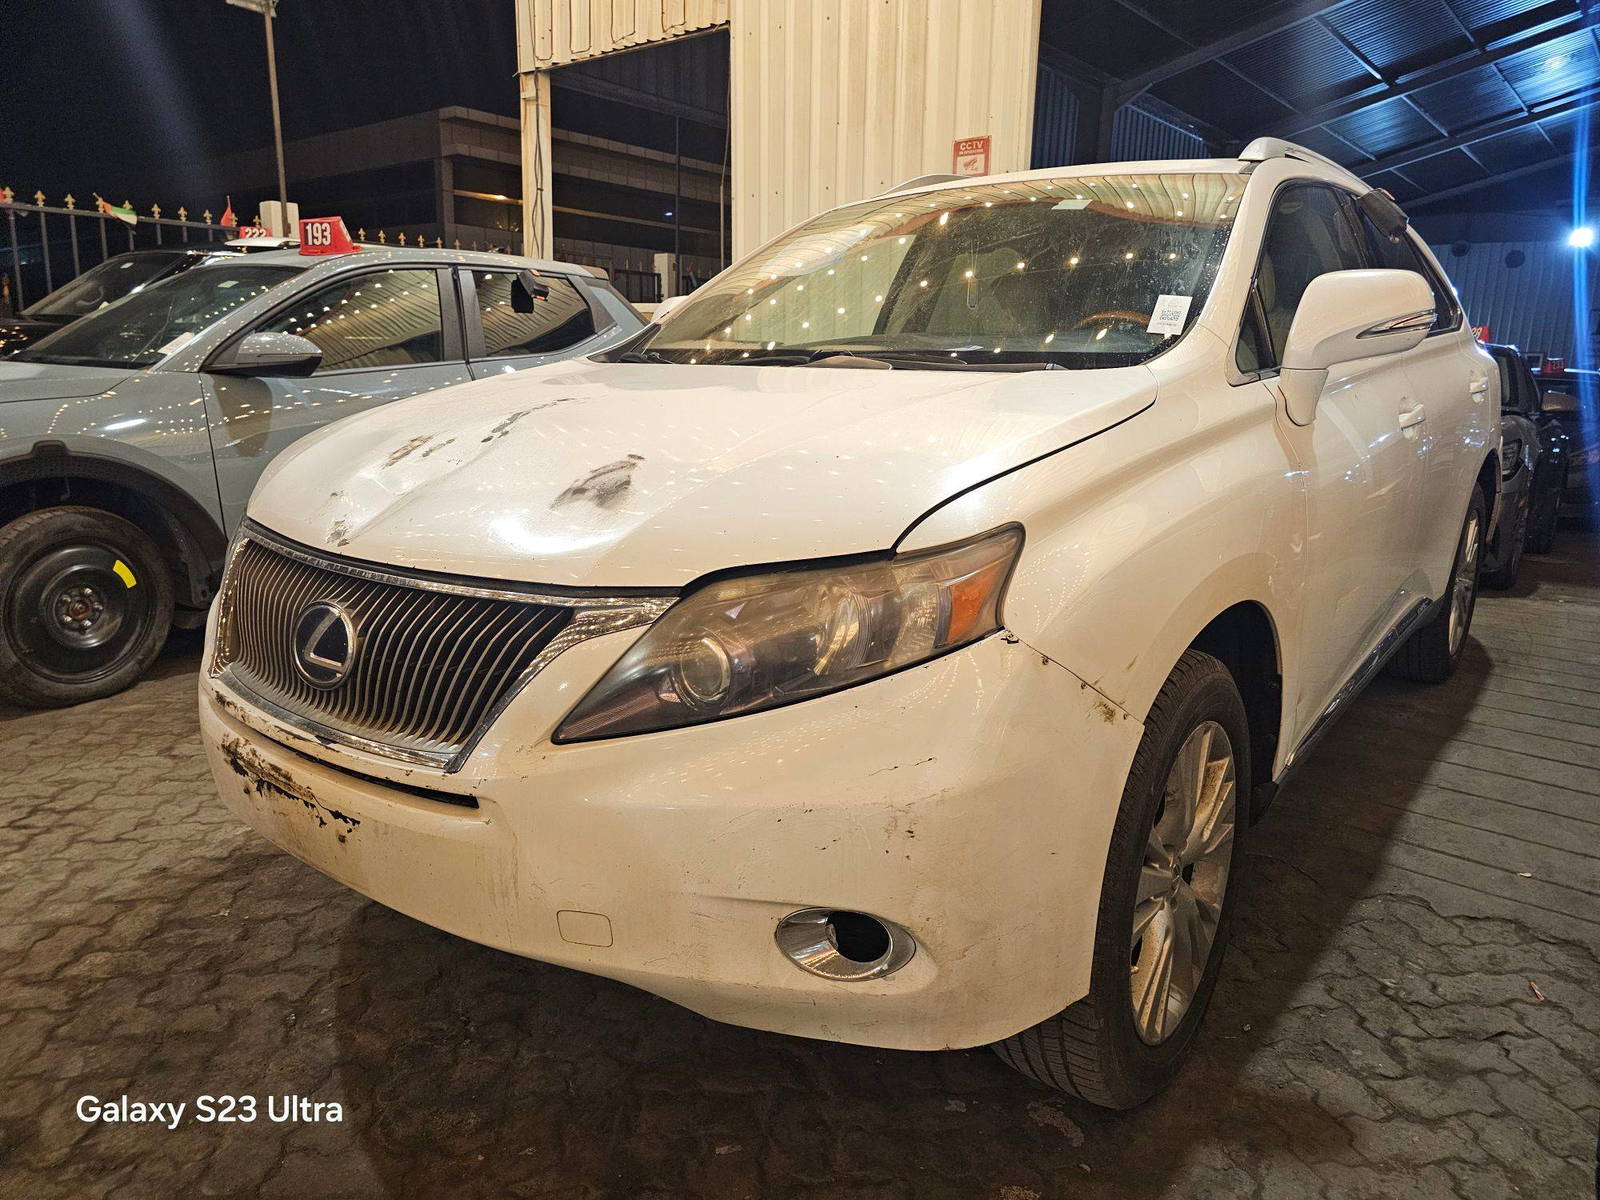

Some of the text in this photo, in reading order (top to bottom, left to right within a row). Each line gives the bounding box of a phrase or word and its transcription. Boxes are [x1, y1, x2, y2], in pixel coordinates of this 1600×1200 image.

[960, 140, 984, 150] CCTV
[244, 227, 267, 239] 222
[305, 222, 331, 246] 193
